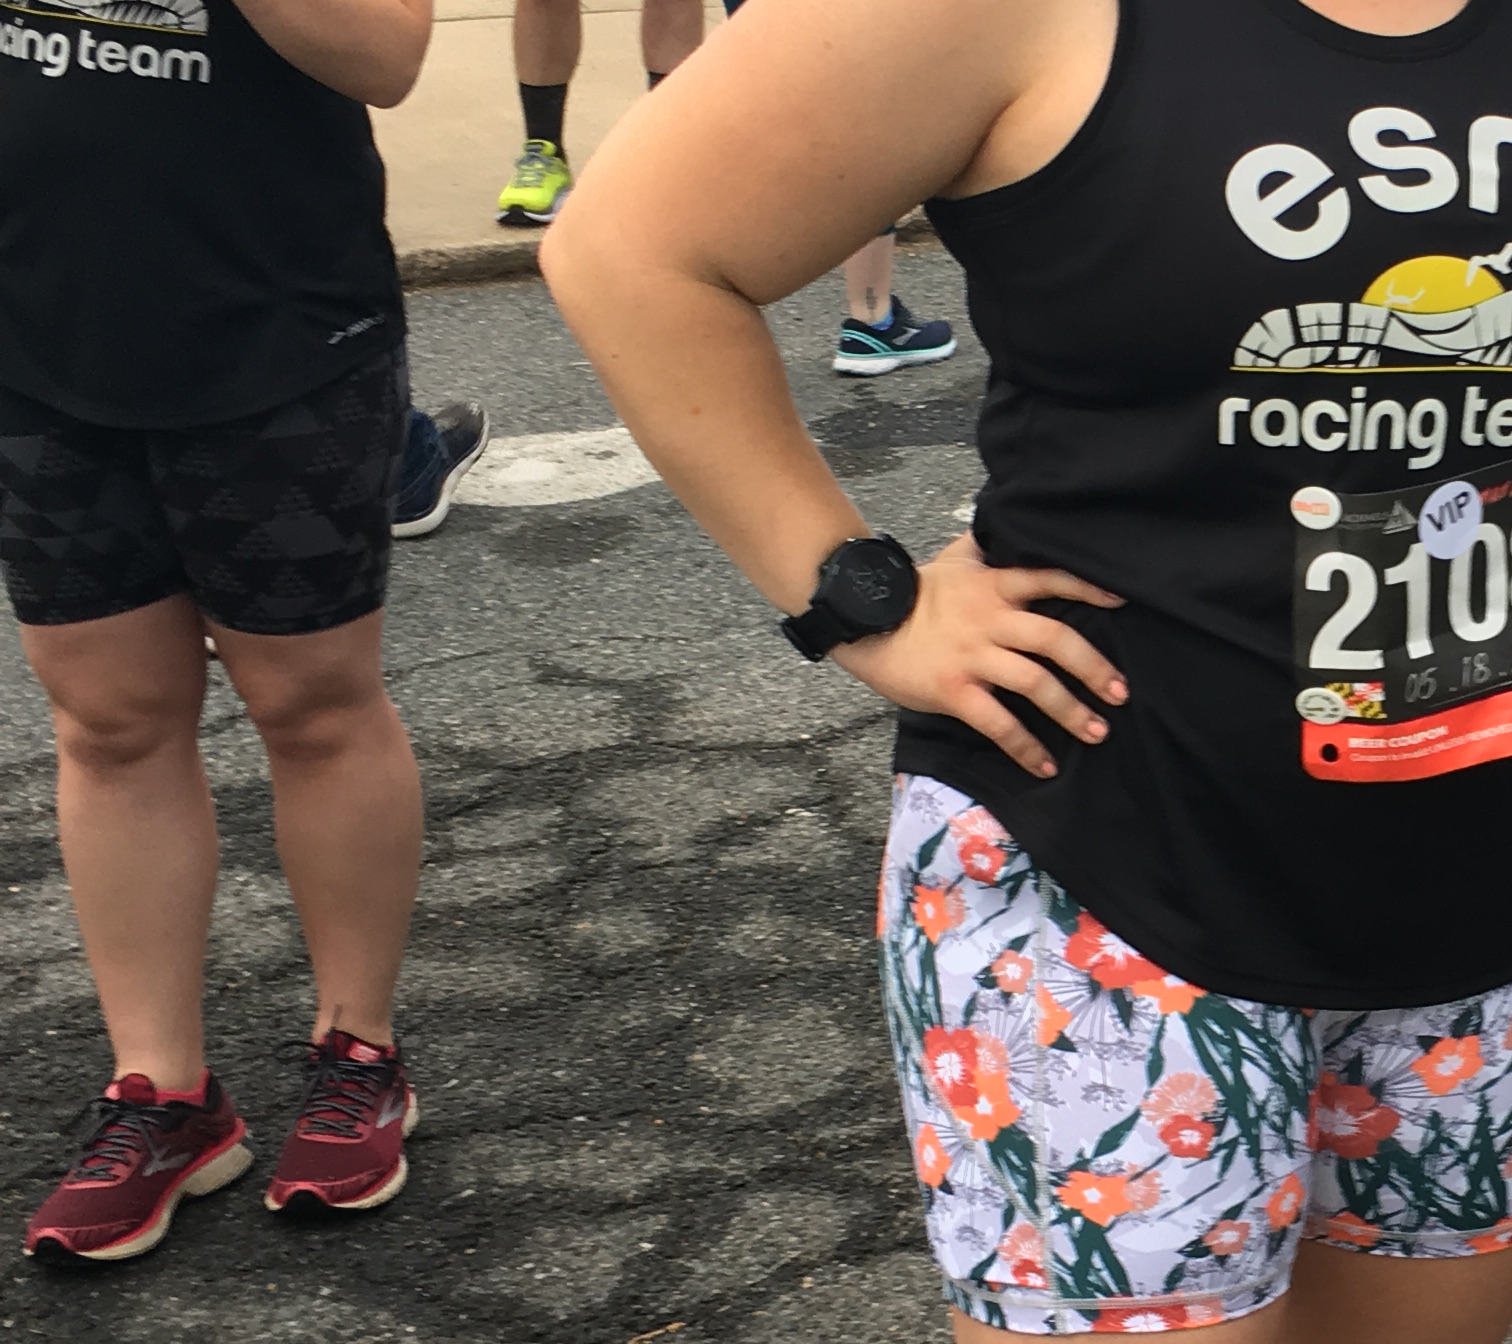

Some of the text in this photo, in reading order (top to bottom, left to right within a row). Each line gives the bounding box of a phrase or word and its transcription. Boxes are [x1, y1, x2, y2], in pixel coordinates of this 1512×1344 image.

[77, 28, 212, 84] team
[1218, 385, 1448, 471] racing
[1425, 490, 1472, 533] VIP
